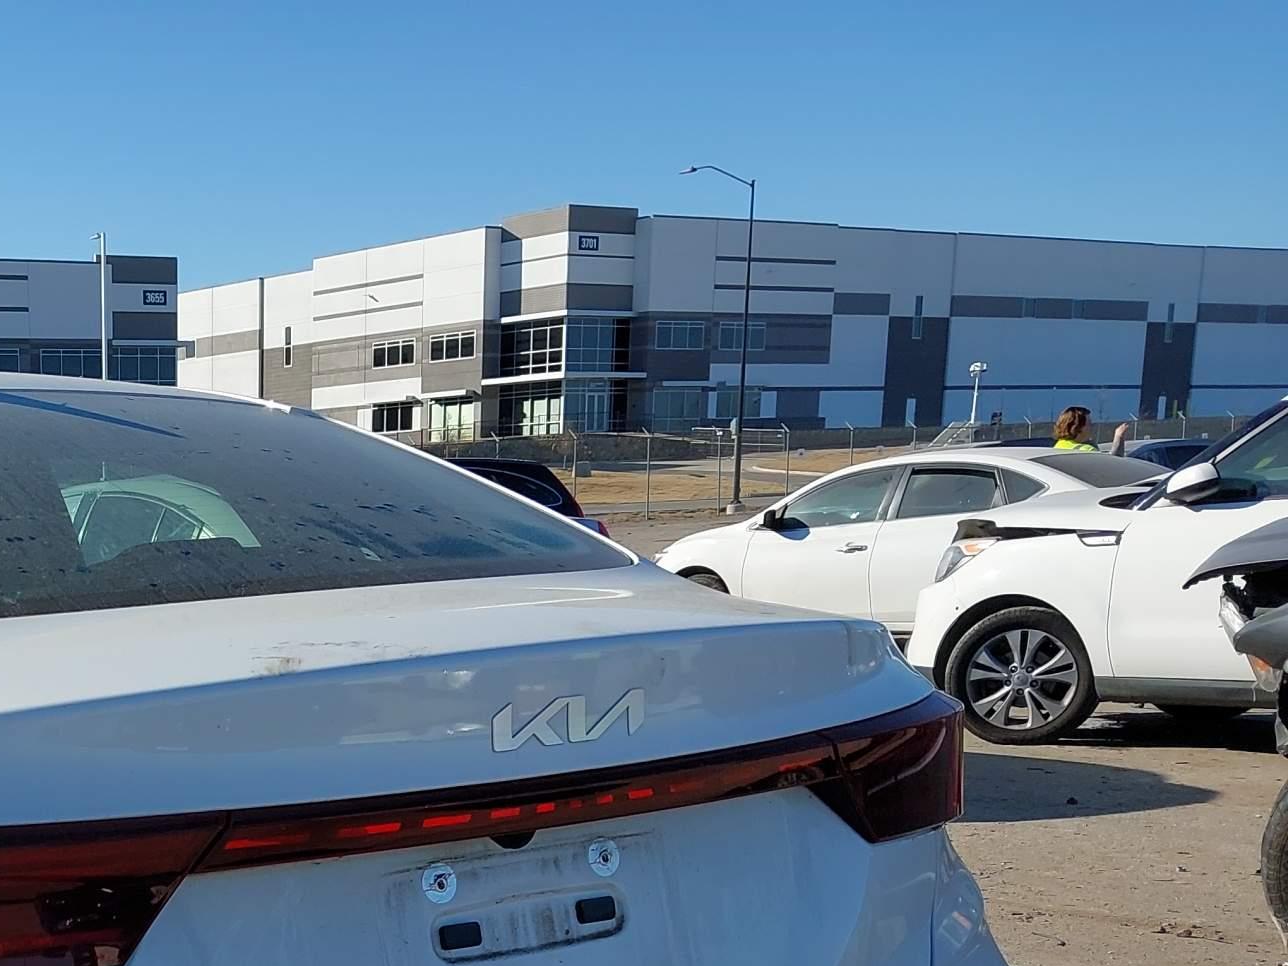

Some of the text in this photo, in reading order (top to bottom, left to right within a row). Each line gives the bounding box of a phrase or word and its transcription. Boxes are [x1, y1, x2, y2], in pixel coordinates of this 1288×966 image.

[581, 237, 597, 249] 3701
[145, 292, 165, 304] 3655
[492, 687, 645, 752] KIA
